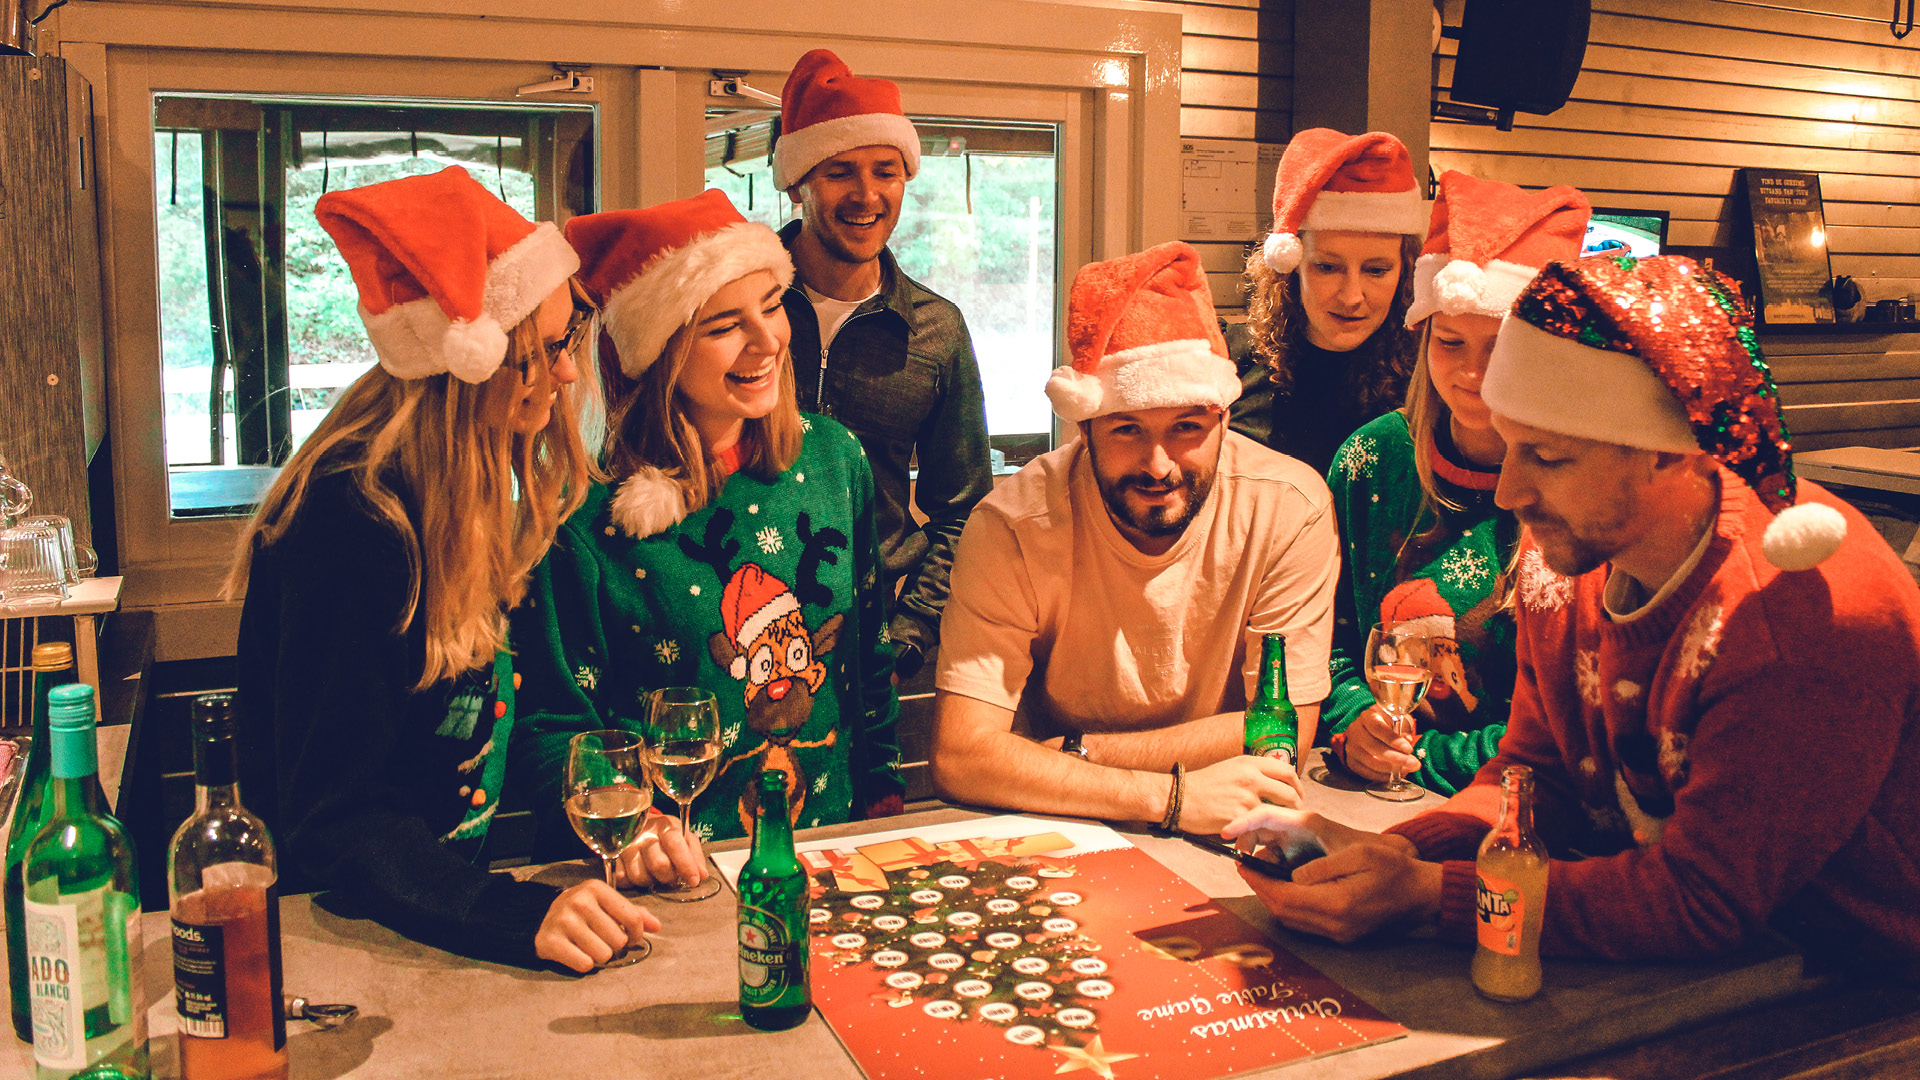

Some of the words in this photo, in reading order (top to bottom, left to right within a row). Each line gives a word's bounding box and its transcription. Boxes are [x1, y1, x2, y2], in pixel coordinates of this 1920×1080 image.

[1216, 982, 1294, 1006] Table
[1136, 997, 1212, 1021] Game
[1190, 997, 1342, 1039] Christmas
